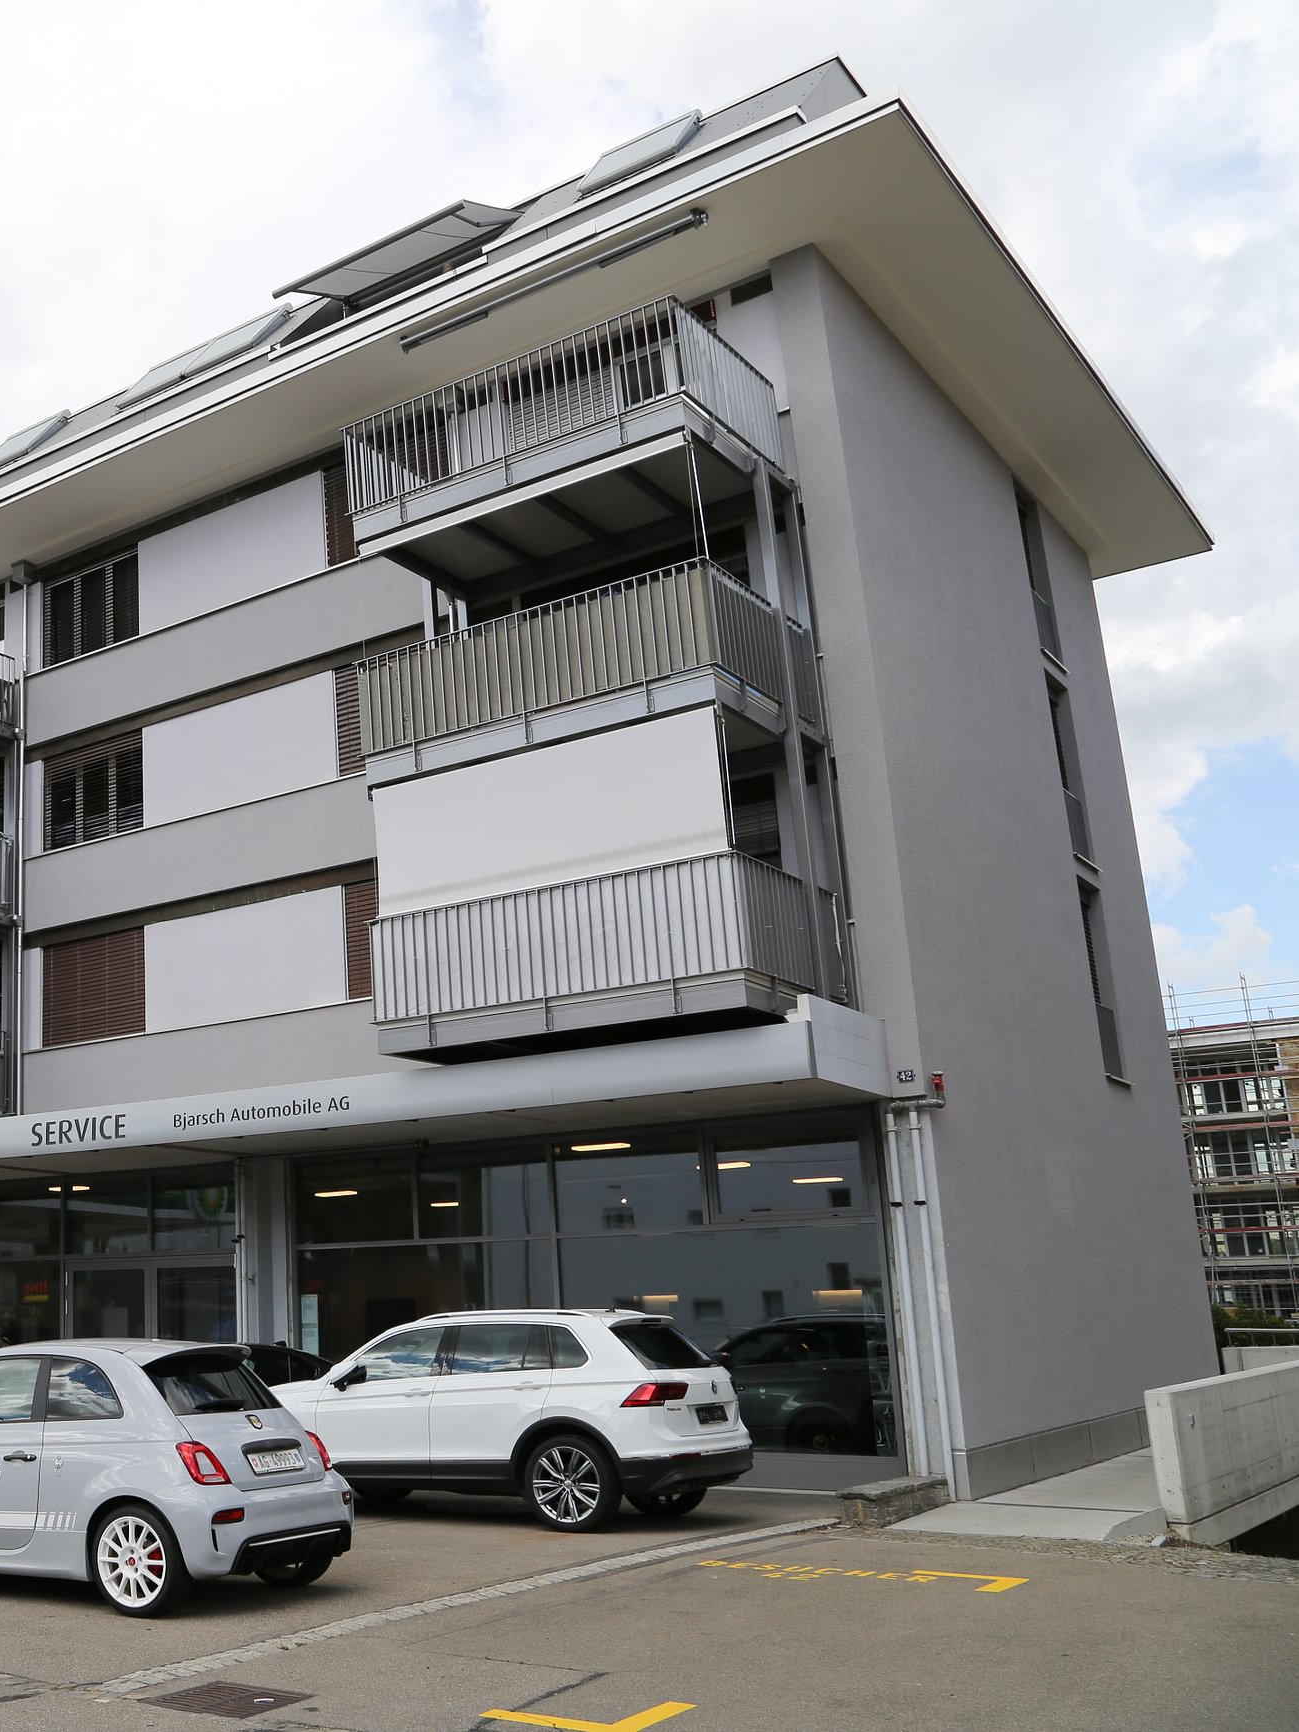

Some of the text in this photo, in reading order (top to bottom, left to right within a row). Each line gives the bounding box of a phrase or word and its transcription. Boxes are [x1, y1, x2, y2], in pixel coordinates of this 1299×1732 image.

[900, 1070, 913, 1081] 42
[172, 1096, 351, 1130] Bjarsch Automobile AG
[31, 1113, 127, 1147] SERVICE
[697, 1559, 938, 1583] BESUCHER
